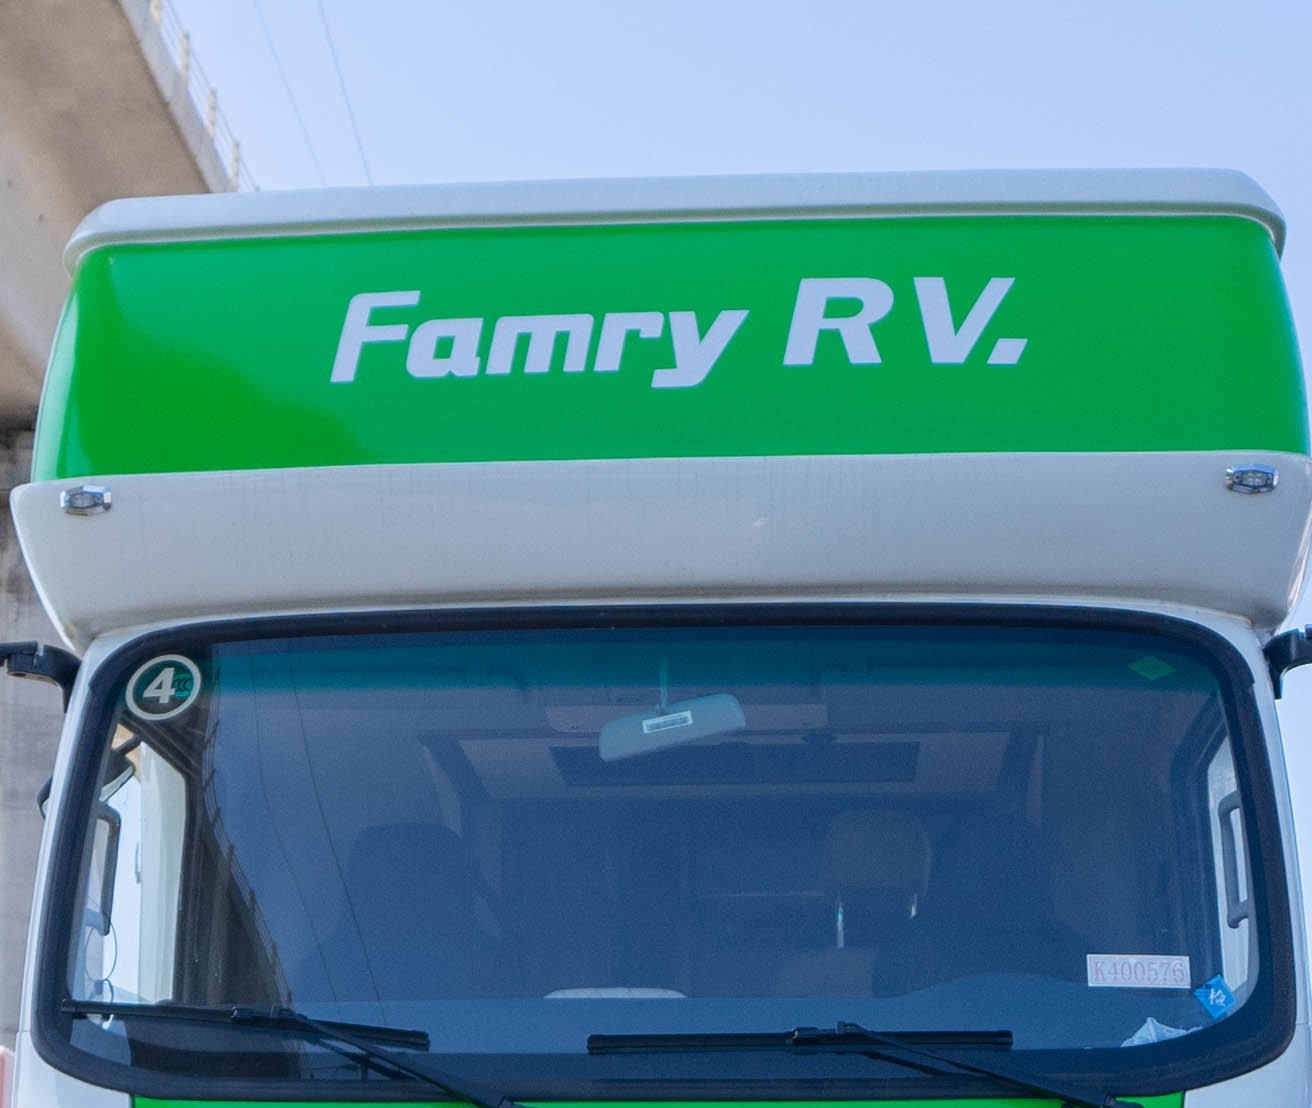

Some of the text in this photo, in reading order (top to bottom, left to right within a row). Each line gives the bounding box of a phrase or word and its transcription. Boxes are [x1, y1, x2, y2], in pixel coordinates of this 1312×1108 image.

[332, 277, 1029, 388] Famry RV.
[143, 667, 176, 704] 4
[1094, 960, 1185, 984] K400576
